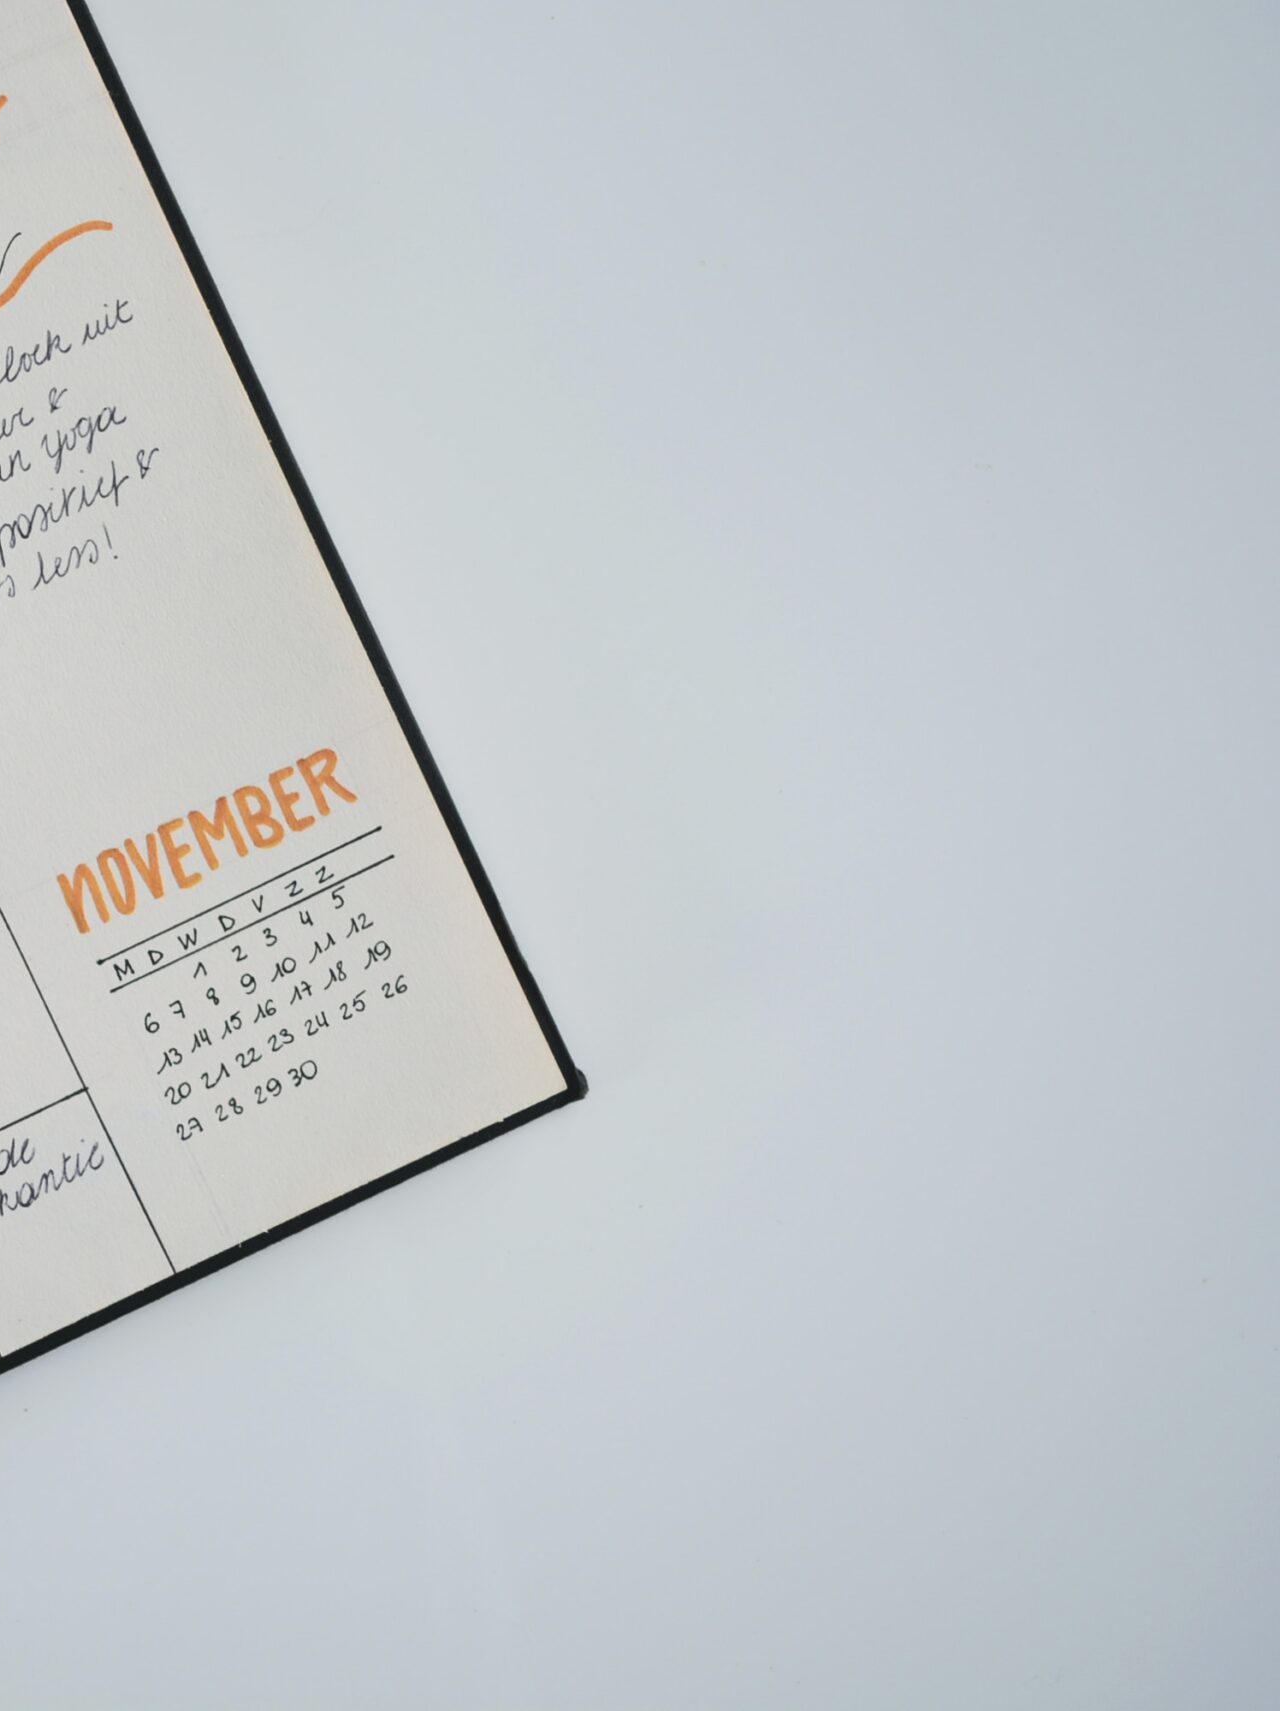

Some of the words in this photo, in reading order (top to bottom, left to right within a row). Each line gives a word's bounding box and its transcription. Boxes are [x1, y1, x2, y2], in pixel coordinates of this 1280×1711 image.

[81, 299, 134, 346] uit
[41, 406, 127, 474] yoga
[56, 748, 358, 935] NOVEMBER
[113, 958, 136, 982] M
[148, 949, 164, 966] D
[177, 928, 199, 951] W
[219, 914, 236, 932] D
[251, 894, 265, 913] V
[284, 880, 305, 897] Z
[315, 866, 335, 884] Z
[143, 1013, 161, 1035] 6
[168, 1000, 187, 1019] 7
[205, 987, 221, 1006] 8
[239, 973, 257, 995] 9
[270, 956, 297, 983] 10
[309, 932, 336, 964] 11
[345, 912, 375, 939] 12
[192, 962, 208, 979] 1
[231, 945, 248, 963] 2
[262, 928, 278, 946] 3
[298, 911, 314, 928] 4
[330, 885, 346, 909] 5
[156, 1046, 183, 1075] 13
[191, 1028, 213, 1054] 14
[221, 1010, 244, 1041] 15
[253, 999, 278, 1024] 16
[289, 979, 313, 1006] 17
[324, 960, 348, 990] 18
[363, 939, 392, 970] 19
[164, 1081, 192, 1106] 20
[200, 1062, 231, 1090] 21
[235, 1046, 263, 1069] 22
[267, 1027, 296, 1053] 23
[304, 1011, 331, 1037] 24
[339, 990, 367, 1021] 25
[381, 974, 408, 999] 26
[176, 1117, 204, 1142] 27
[215, 1098, 245, 1123] 28
[254, 1076, 284, 1105] 29
[287, 1059, 319, 1087] 30
